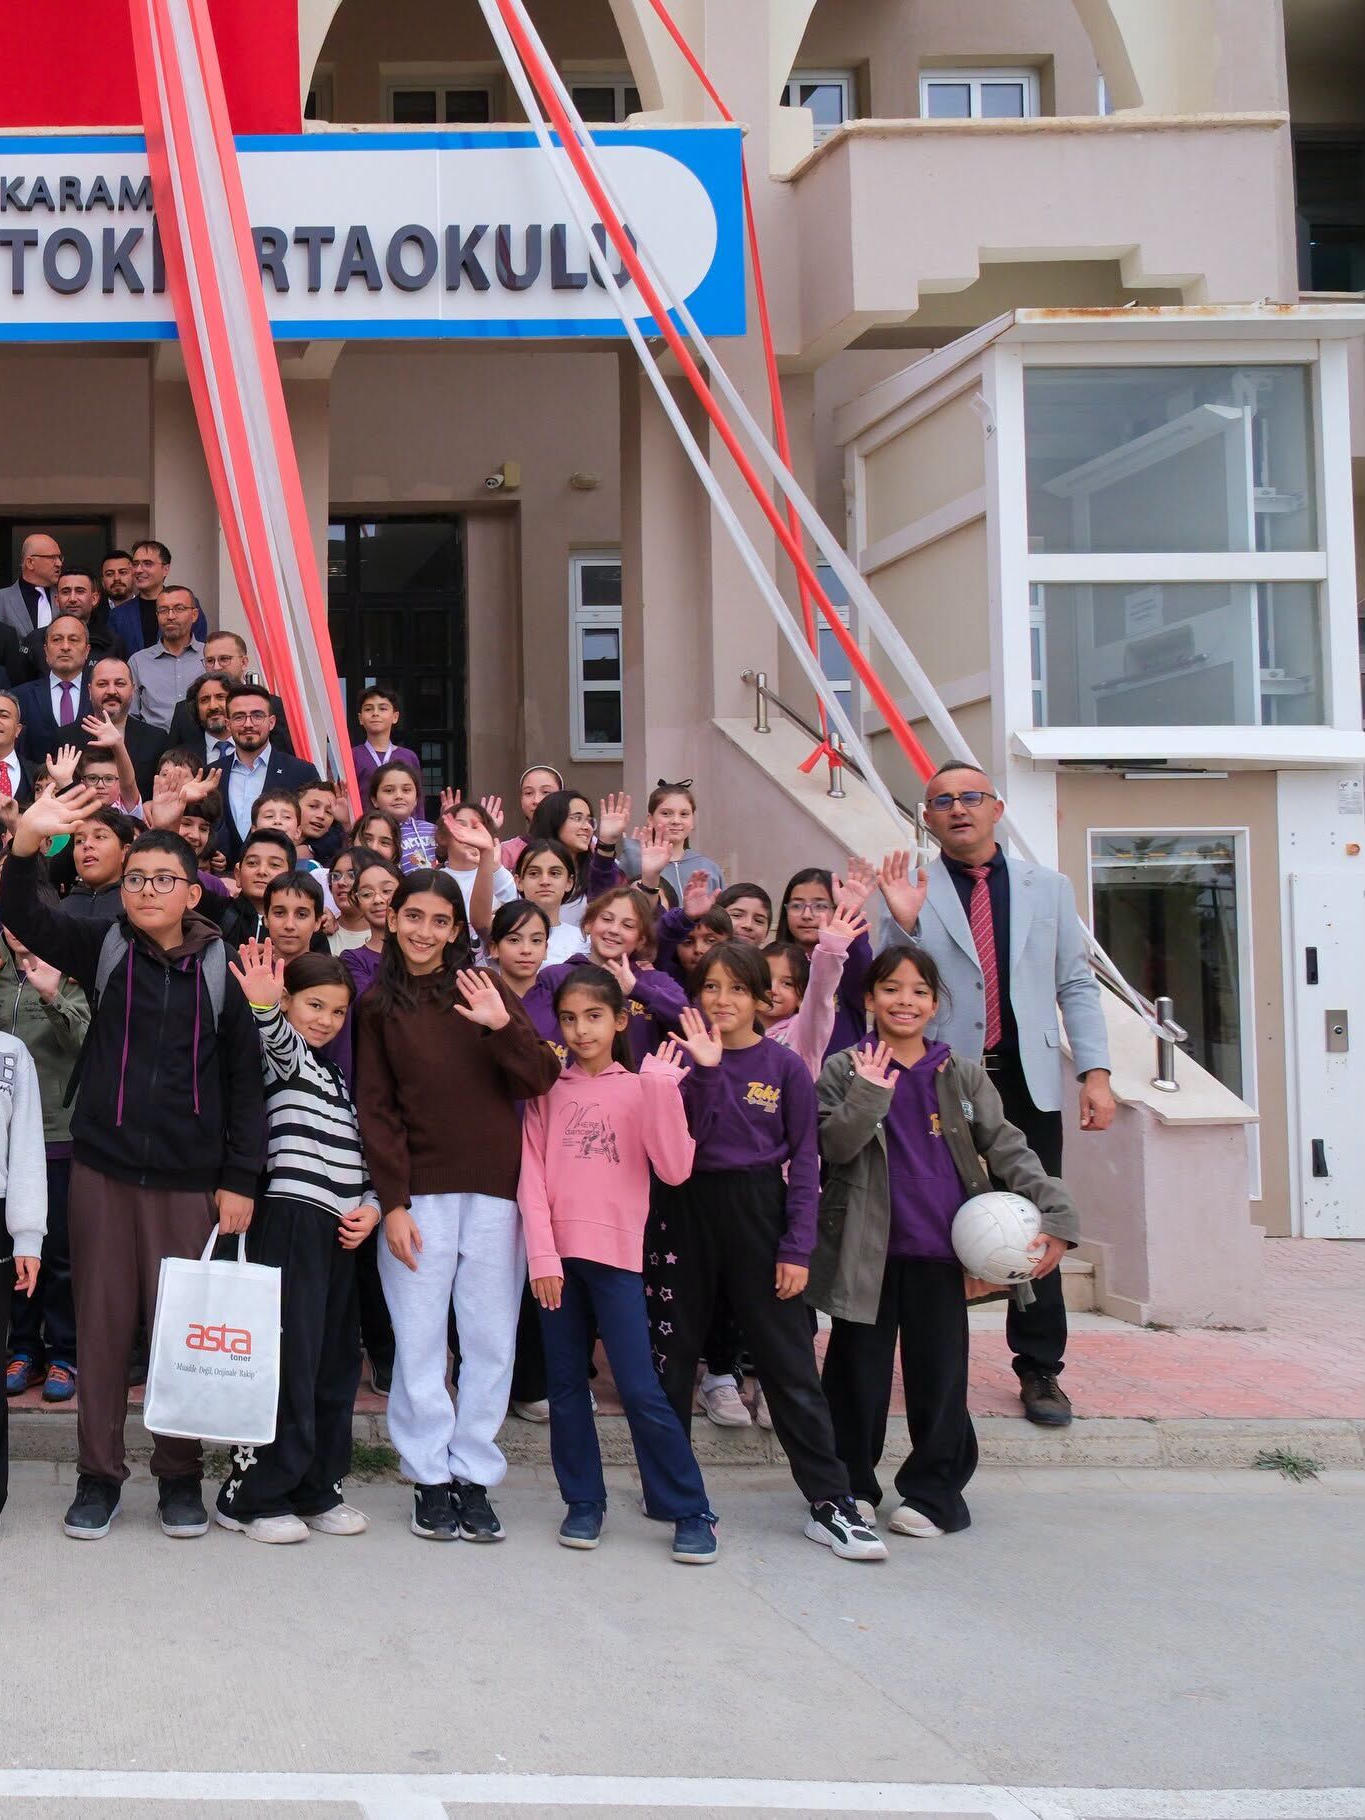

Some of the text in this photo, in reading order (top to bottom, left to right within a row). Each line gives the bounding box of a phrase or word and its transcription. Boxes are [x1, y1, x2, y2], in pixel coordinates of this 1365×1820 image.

[0, 175, 153, 213] KARAM
[250, 223, 638, 293] RTAOKULU
[186, 1323, 252, 1355] asta
[230, 1353, 252, 1362] toner
